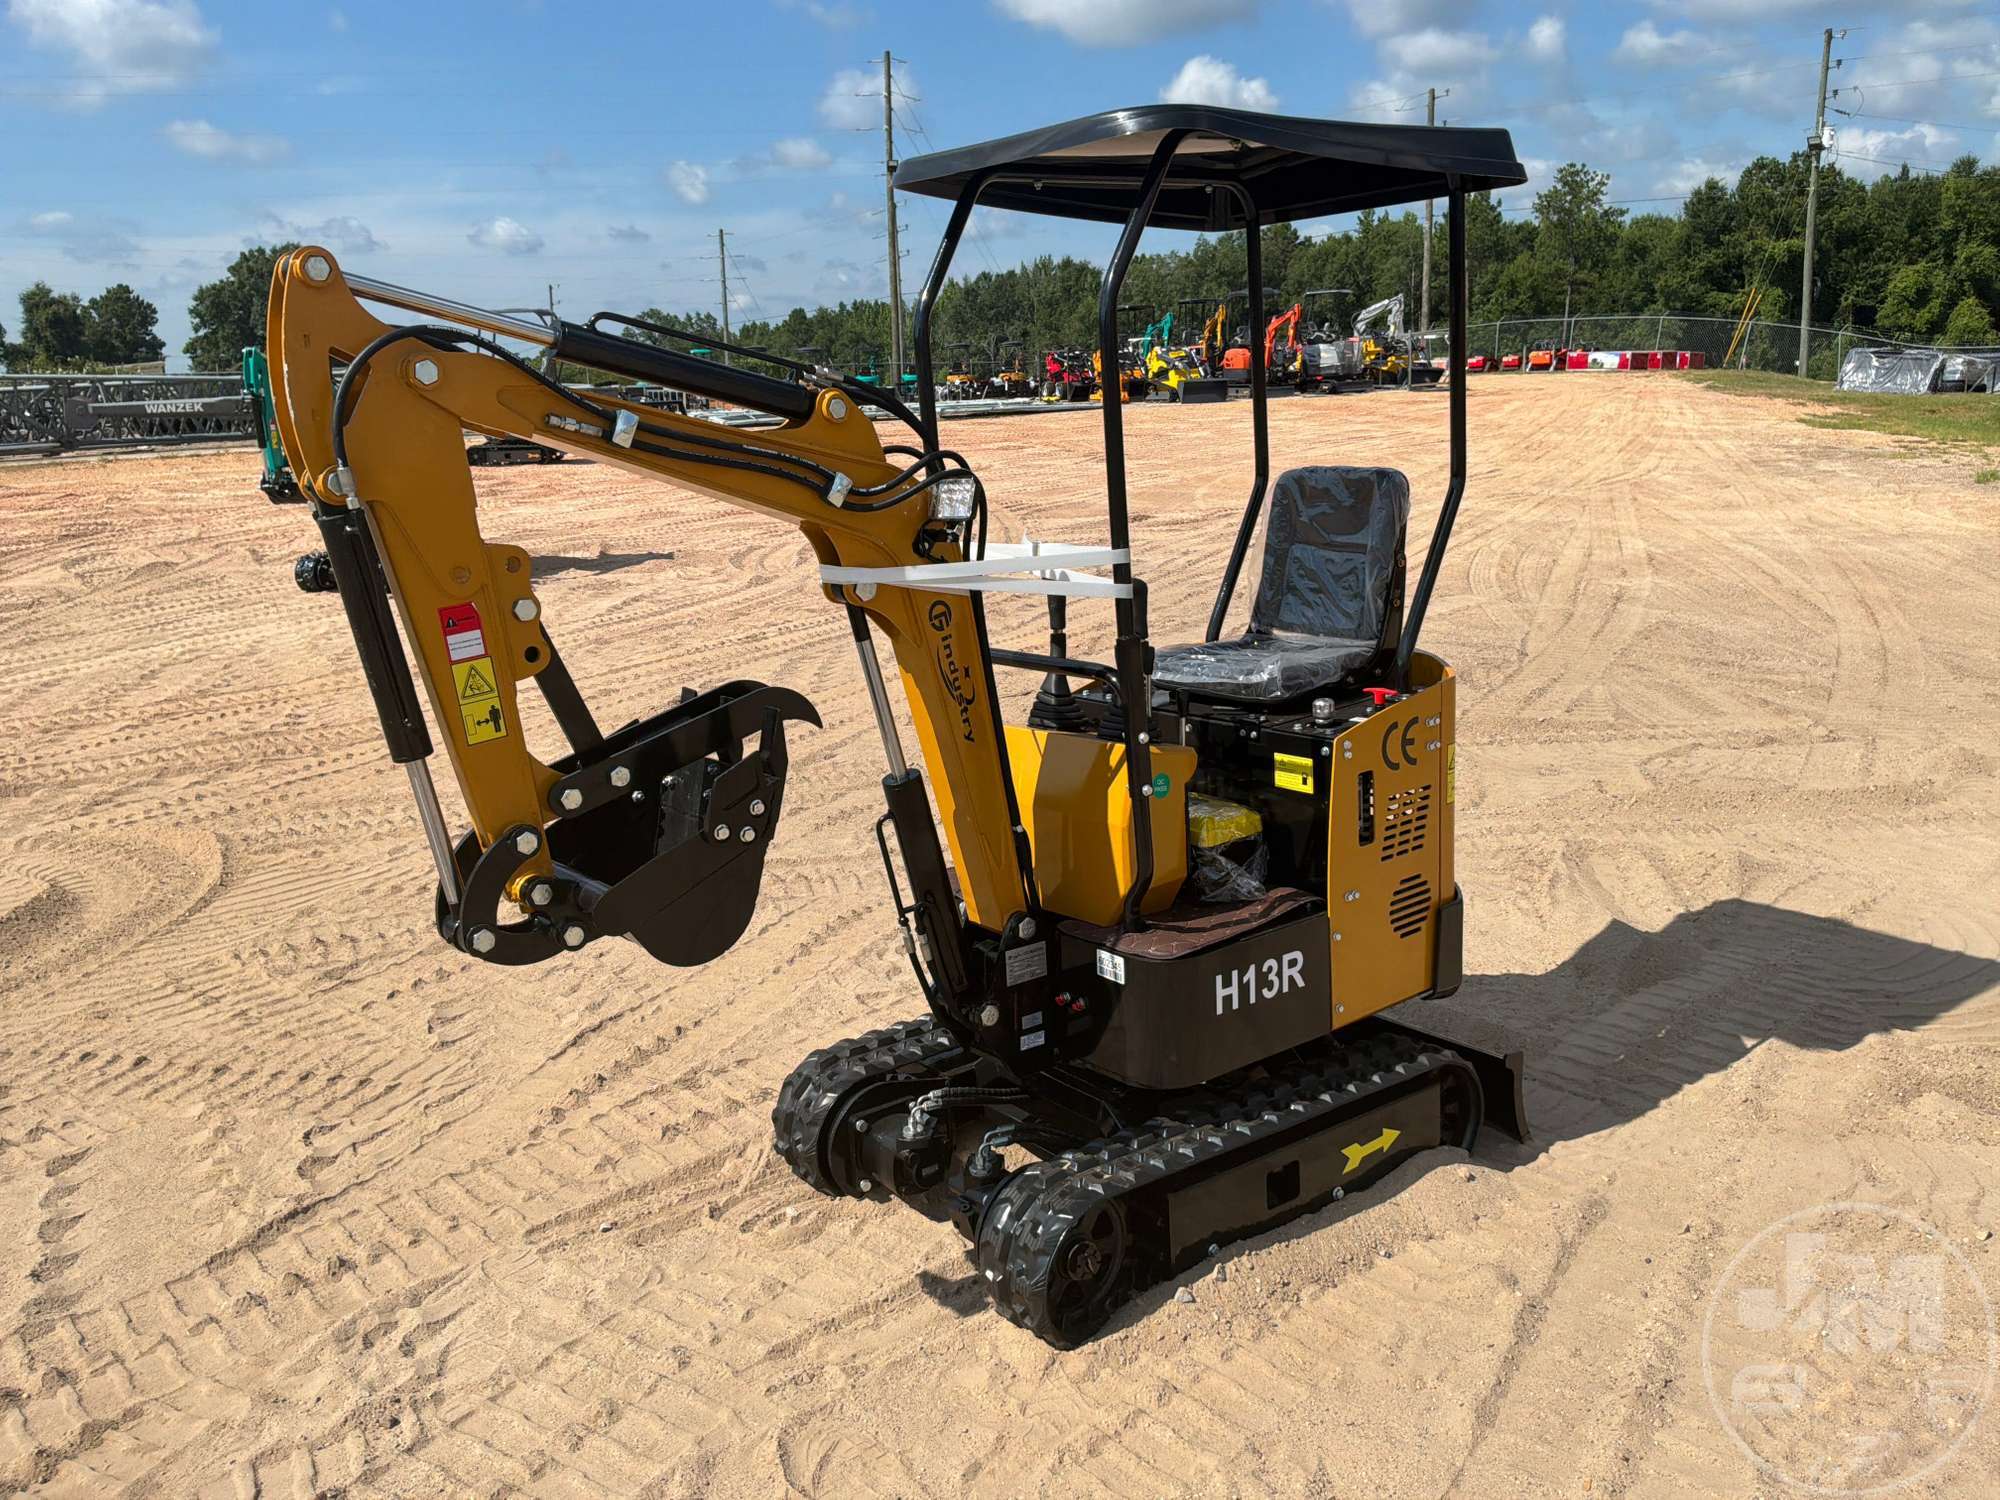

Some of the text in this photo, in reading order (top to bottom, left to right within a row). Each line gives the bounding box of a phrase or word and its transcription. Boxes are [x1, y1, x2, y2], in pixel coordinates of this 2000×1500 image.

[145, 402, 204, 414] WANZEK
[1382, 716, 1419, 771] CE
[1215, 950, 1306, 1016] H13R
